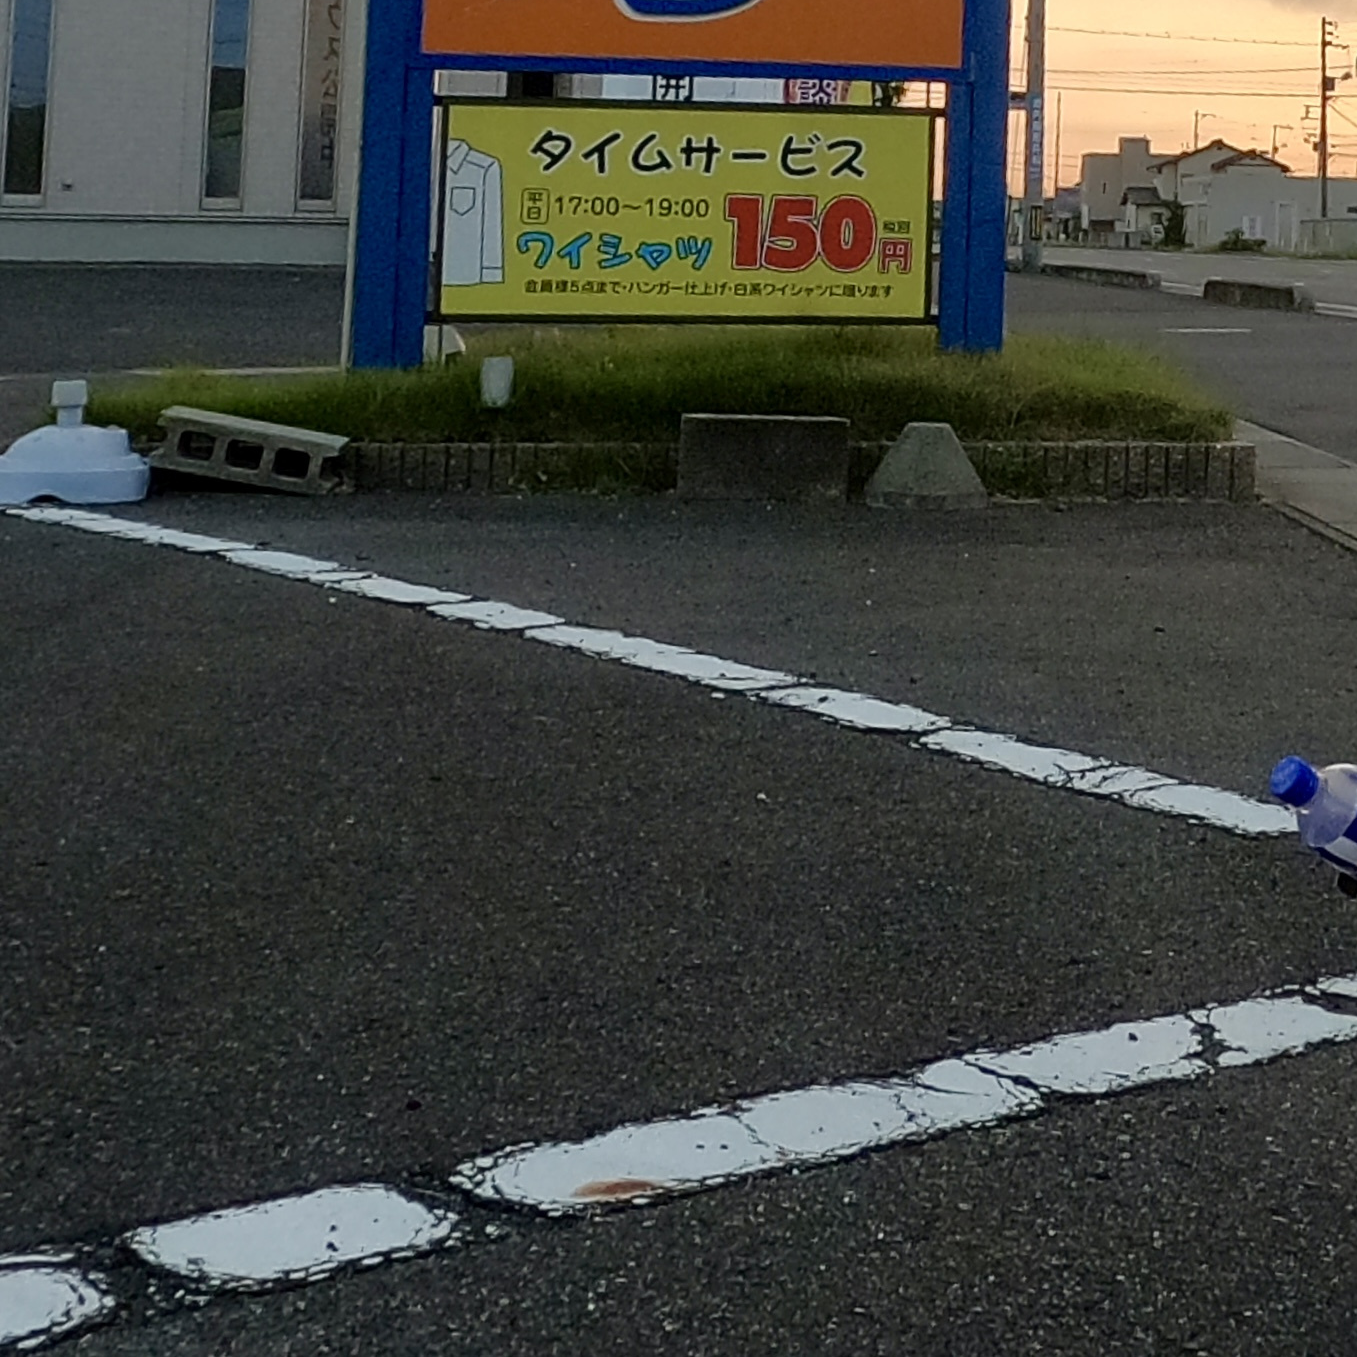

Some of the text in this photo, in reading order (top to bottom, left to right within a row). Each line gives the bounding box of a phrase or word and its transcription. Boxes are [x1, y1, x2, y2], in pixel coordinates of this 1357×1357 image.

[530, 129, 869, 180] タイムサービス
[526, 191, 544, 220] 平日
[516, 230, 713, 271] ワイシャツ
[724, 194, 912, 274] 150 円
